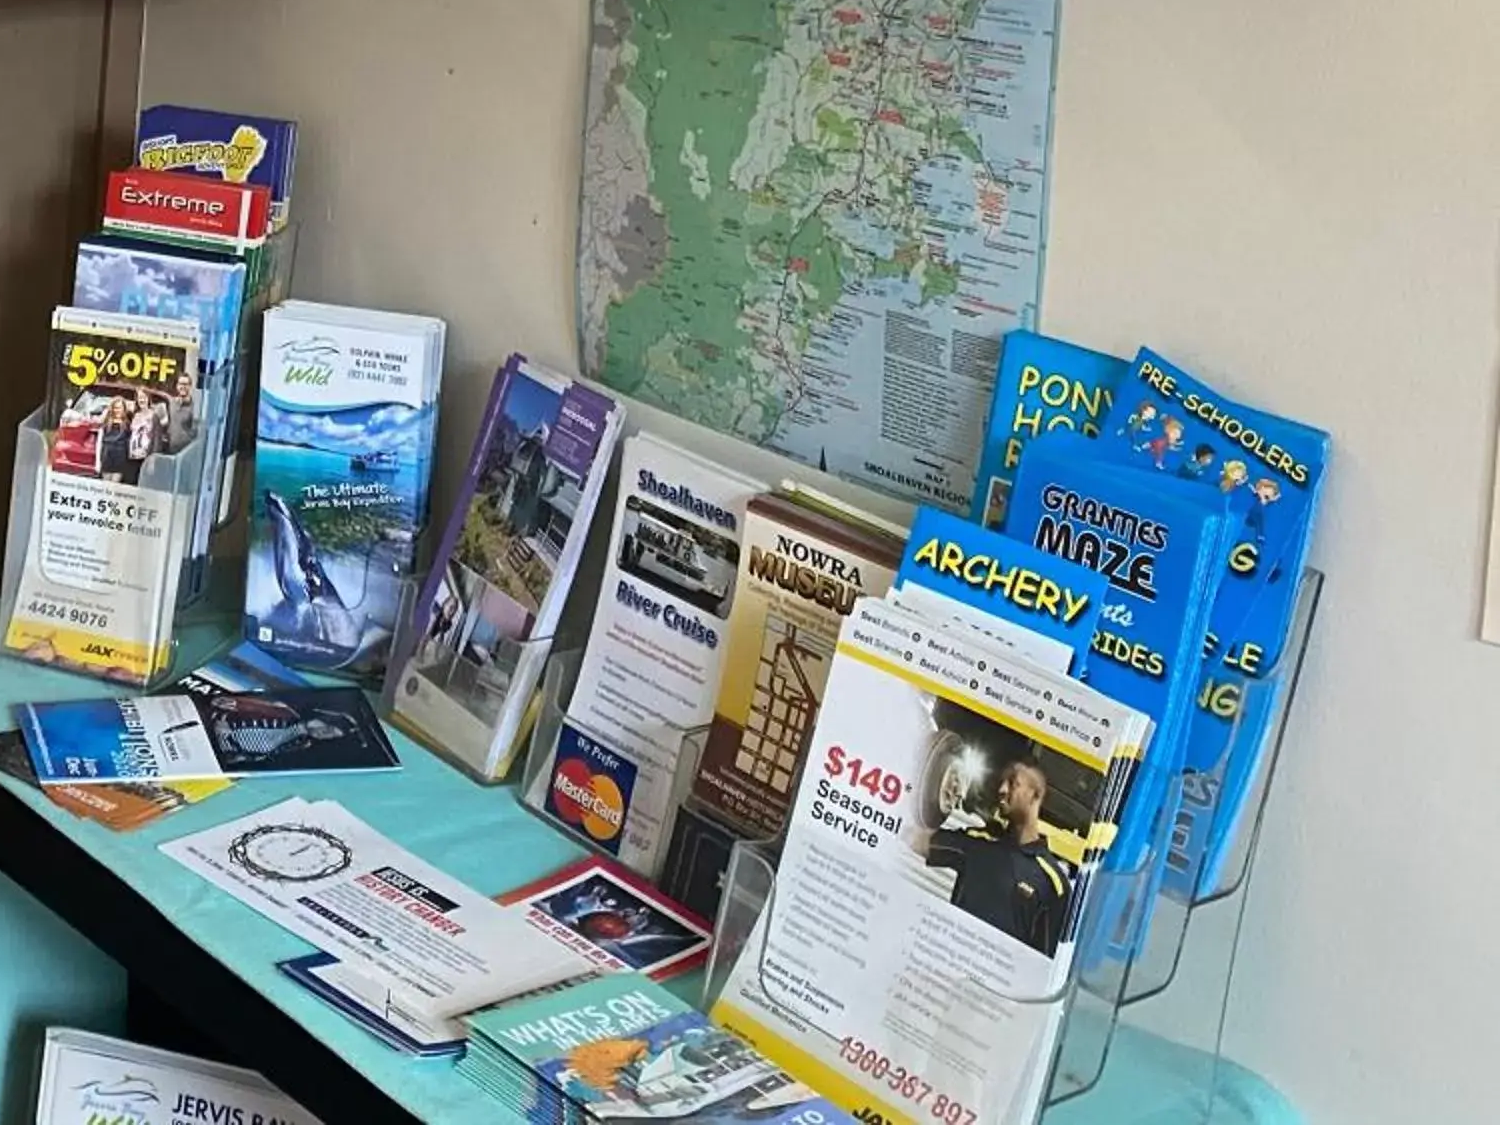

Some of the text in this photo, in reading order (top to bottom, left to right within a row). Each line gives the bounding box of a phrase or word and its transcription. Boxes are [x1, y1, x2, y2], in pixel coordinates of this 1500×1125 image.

[122, 186, 225, 216] Extreme
[67, 344, 177, 387] 5% OFF
[284, 365, 334, 386] Wild
[1138, 362, 1309, 484] PRE-SCHOOLERS
[49, 490, 160, 523] Extra 5% OFF
[300, 482, 389, 498] The Ultimate
[637, 468, 737, 531] Shoalhaven
[47, 509, 125, 533] your invoice
[749, 545, 867, 617] MUSEU
[775, 533, 864, 589] NOWRA
[913, 537, 1090, 624] ARCHERY
[1034, 517, 1156, 600] MAZE
[27, 599, 67, 620] 4424
[69, 610, 109, 628] 9076
[615, 578, 720, 650] River Cruise
[81, 642, 114, 659] JAX
[853, 629, 874, 645] Best
[919, 658, 940, 675] Best
[1049, 716, 1070, 733] Best
[577, 736, 620, 770] We Prefer
[553, 772, 621, 826] MasterCard
[816, 777, 904, 836] Seasonal
[810, 800, 879, 851] Service
[354, 874, 412, 904] HISTORY
[501, 989, 661, 1047] WHAT'S ON
[618, 1004, 672, 1032] ARTS
[838, 1035, 979, 1125] 1300 367 897
[171, 1091, 246, 1125] JERVIS
